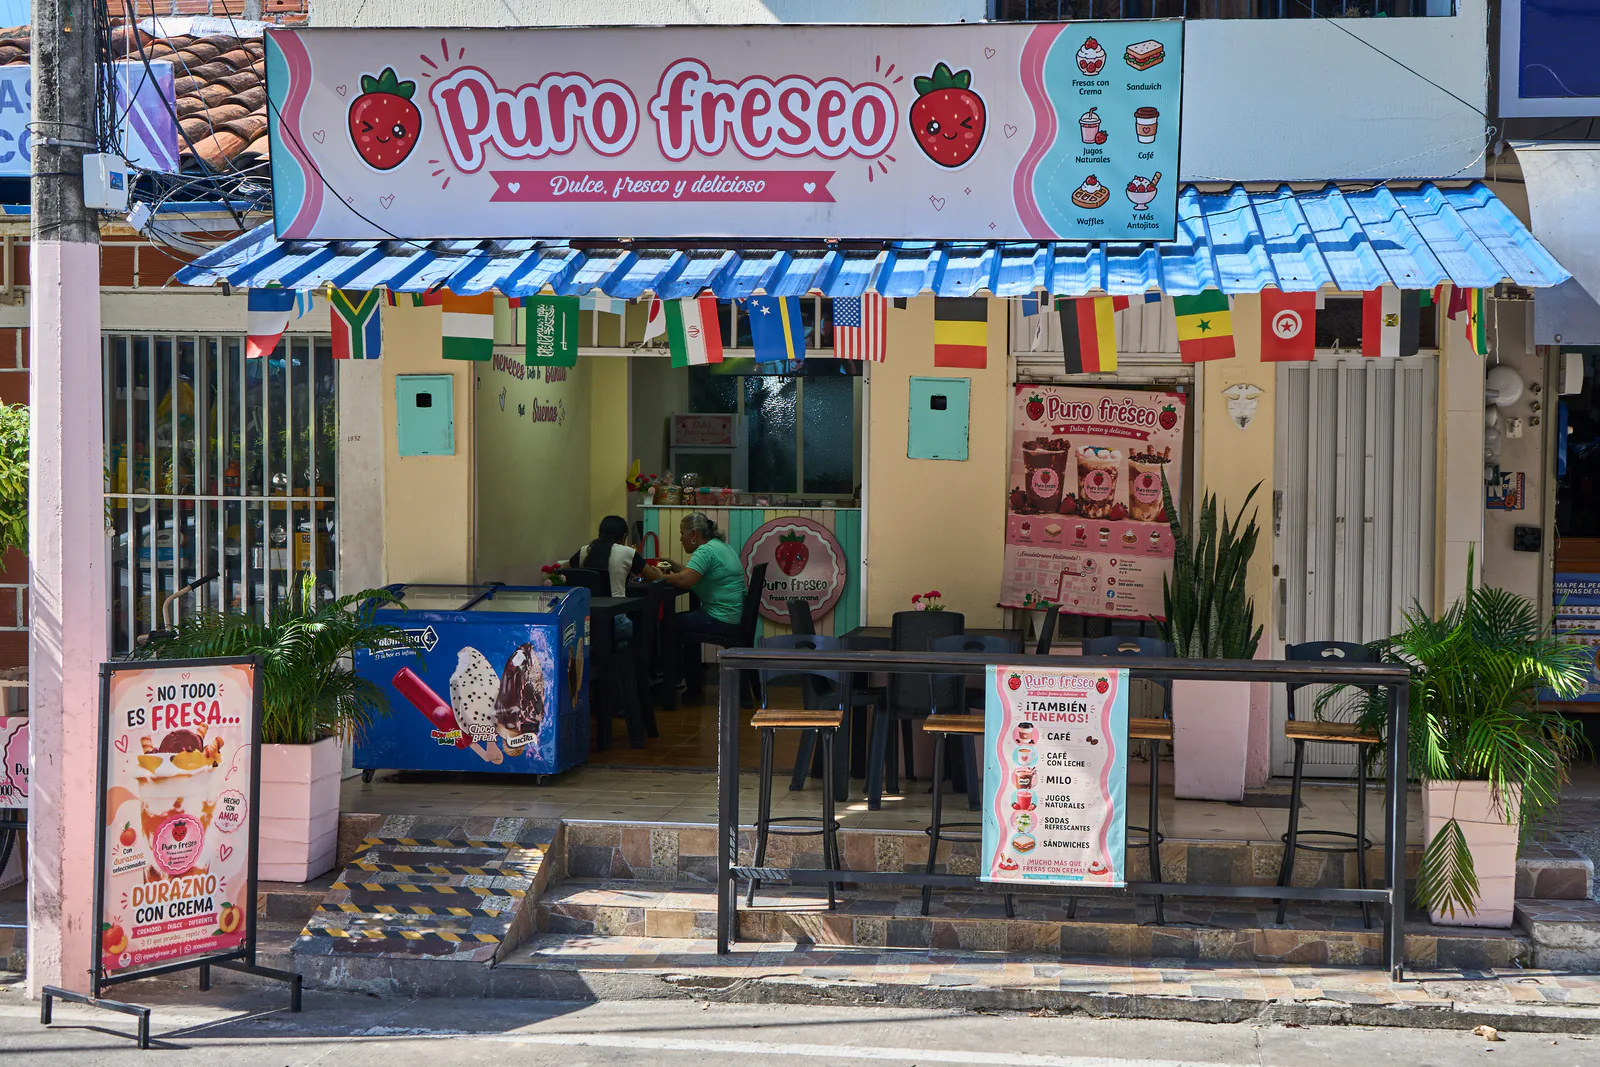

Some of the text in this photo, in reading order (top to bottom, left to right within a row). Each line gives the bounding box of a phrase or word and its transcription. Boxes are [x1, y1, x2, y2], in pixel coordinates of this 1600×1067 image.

[1072, 79, 1095, 87] Fresas
[1126, 83, 1162, 91] Sandwich
[653, 62, 893, 157] freseo
[1083, 147, 1103, 156] Jugos
[1138, 152, 1154, 160] Café
[550, 175, 766, 198] Dulce, fresco y delicioso
[1076, 217, 1104, 226] Waffles
[1127, 221, 1159, 230] Antojitos
[532, 397, 558, 424] Sueñas
[1047, 396, 1157, 426] Puro freseo
[1087, 426, 1104, 434] fresco
[1109, 428, 1132, 437] delicioso
[1024, 674, 1095, 688] Puro freseo
[157, 682, 216, 702] NO TODO
[1026, 701, 1087, 713] ¡TAMBIÉN
[126, 700, 241, 731] ES FRESA...
[1024, 712, 1089, 723] TENEMOS!
[468, 724, 496, 735] Choco
[471, 733, 499, 743] Break
[1047, 731, 1071, 741] CAFÉ
[1047, 751, 1067, 760] CAFÉ
[15, 763, 29, 776] Pu
[1064, 760, 1085, 768] LECHE
[1046, 776, 1072, 785] MILO
[223, 797, 241, 805] HECHO
[1045, 794, 1071, 802] JUGOS
[1045, 802, 1085, 810] NATURALES
[218, 811, 239, 823] AMOR
[1044, 816, 1070, 824] SODAS
[1044, 824, 1091, 832] REFRESCANTES
[113, 852, 144, 866] duraznos
[112, 860, 146, 874] seleccionados
[1062, 867, 1086, 875] CREMA!
[132, 875, 217, 908] DURAZNO
[135, 896, 214, 924] CON CREMA
[136, 916, 213, 936] CREMOSO DULCE DIFERENTE
